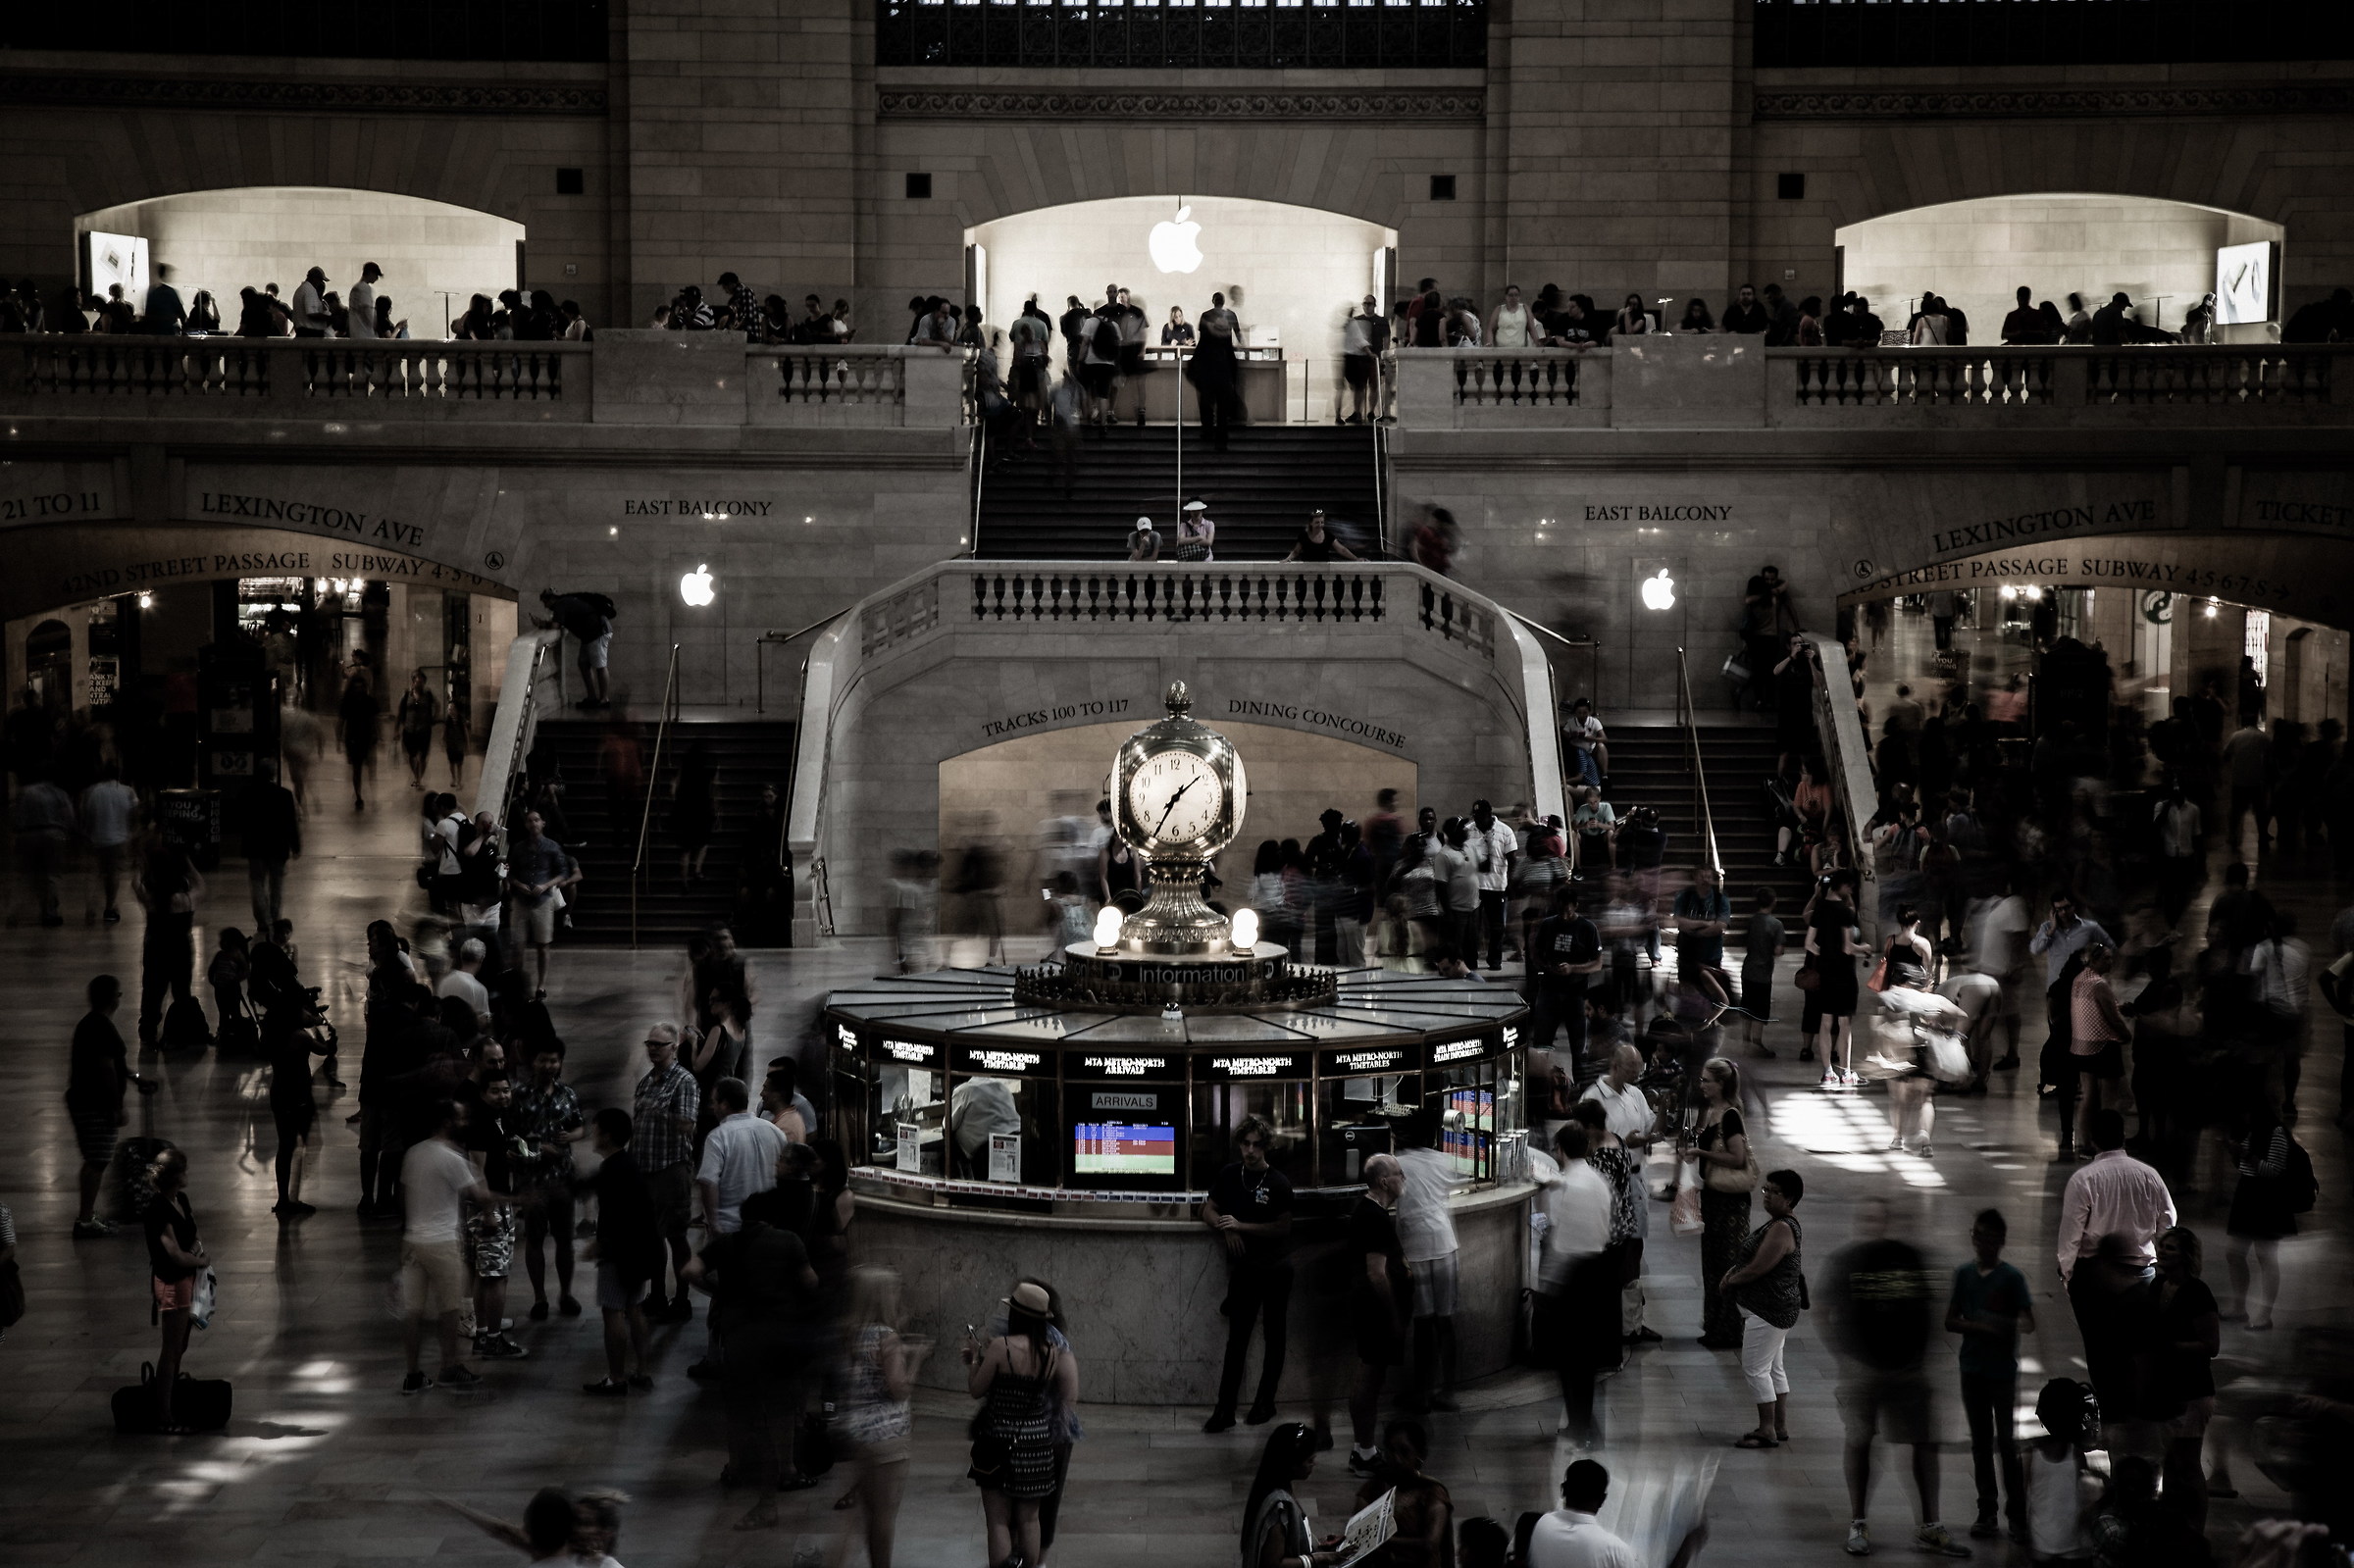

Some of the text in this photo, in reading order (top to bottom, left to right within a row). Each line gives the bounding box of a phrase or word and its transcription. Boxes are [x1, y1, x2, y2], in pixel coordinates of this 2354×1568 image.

[2, 492, 100, 520] 21 TO 11
[625, 500, 772, 516] EAST BALCONY
[202, 492, 424, 546] LEXINGTON AVE
[1585, 506, 1732, 521] EAST BALCONY
[2256, 500, 2353, 528] TICKET
[1932, 500, 2156, 553] LEXINGTON AVE
[62, 568, 120, 594] 42ND
[126, 556, 207, 582] STREET
[214, 552, 310, 572] PASSAGE
[332, 553, 425, 577] SUBWAY
[1880, 563, 1963, 589] STREET
[1970, 558, 2068, 579] PASSAGE
[2081, 559, 2179, 582] SUBWAY
[982, 699, 1129, 736] TRACKS 100 TO 117
[1229, 699, 1407, 749] DINING CONCOURSE
[1154, 764, 1162, 775] 11
[1170, 759, 1181, 771] 12
[1191, 764, 1196, 775] 1
[1142, 777, 1151, 787] 10
[1139, 792, 1146, 805] 9
[1206, 792, 1213, 805] 3
[1144, 810, 1151, 822] 8
[1202, 809, 1209, 821] 4
[1172, 825, 1180, 836] 6
[1189, 822, 1197, 834] 5
[1139, 964, 1245, 984] Information
[969, 1049, 985, 1060] MTA
[1336, 1050, 1403, 1064] MTA METRO-NORTH
[1085, 1057, 1102, 1066] MTA
[1212, 1058, 1231, 1068] MTA
[1349, 1059, 1390, 1070] TIMETABLES
[1104, 1066, 1145, 1075] ARRIVALS
[1096, 1096, 1153, 1107] ARRIVALS
